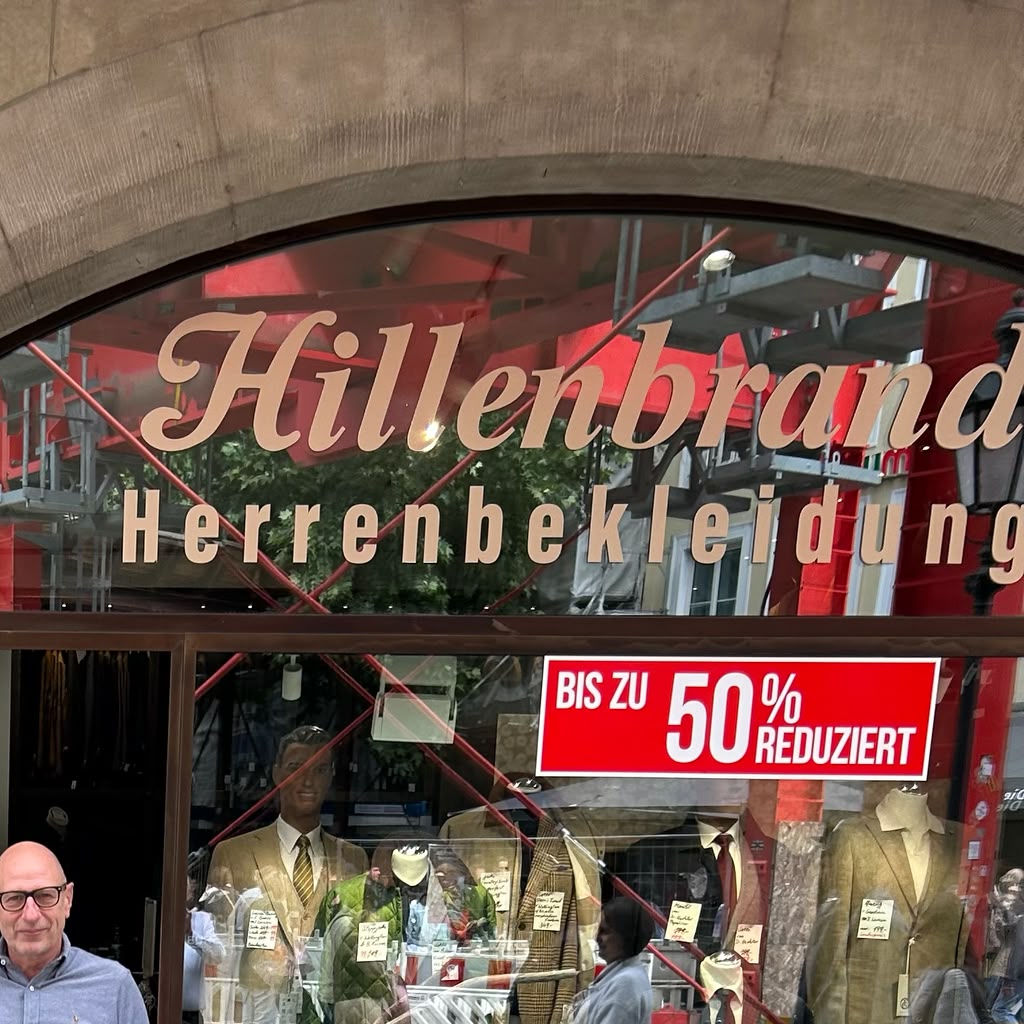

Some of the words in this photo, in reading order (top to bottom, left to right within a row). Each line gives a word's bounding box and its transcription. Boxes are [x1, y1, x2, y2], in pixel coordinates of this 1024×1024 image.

[140, 310, 1024, 452] Hillenbrand
[122, 485, 1024, 585] Herrenbekleidung
[556, 671, 603, 710] BIS
[610, 671, 649, 710] ZU
[666, 671, 755, 764] 50
[761, 673, 802, 725] %
[755, 726, 917, 766] REDUZIERT
